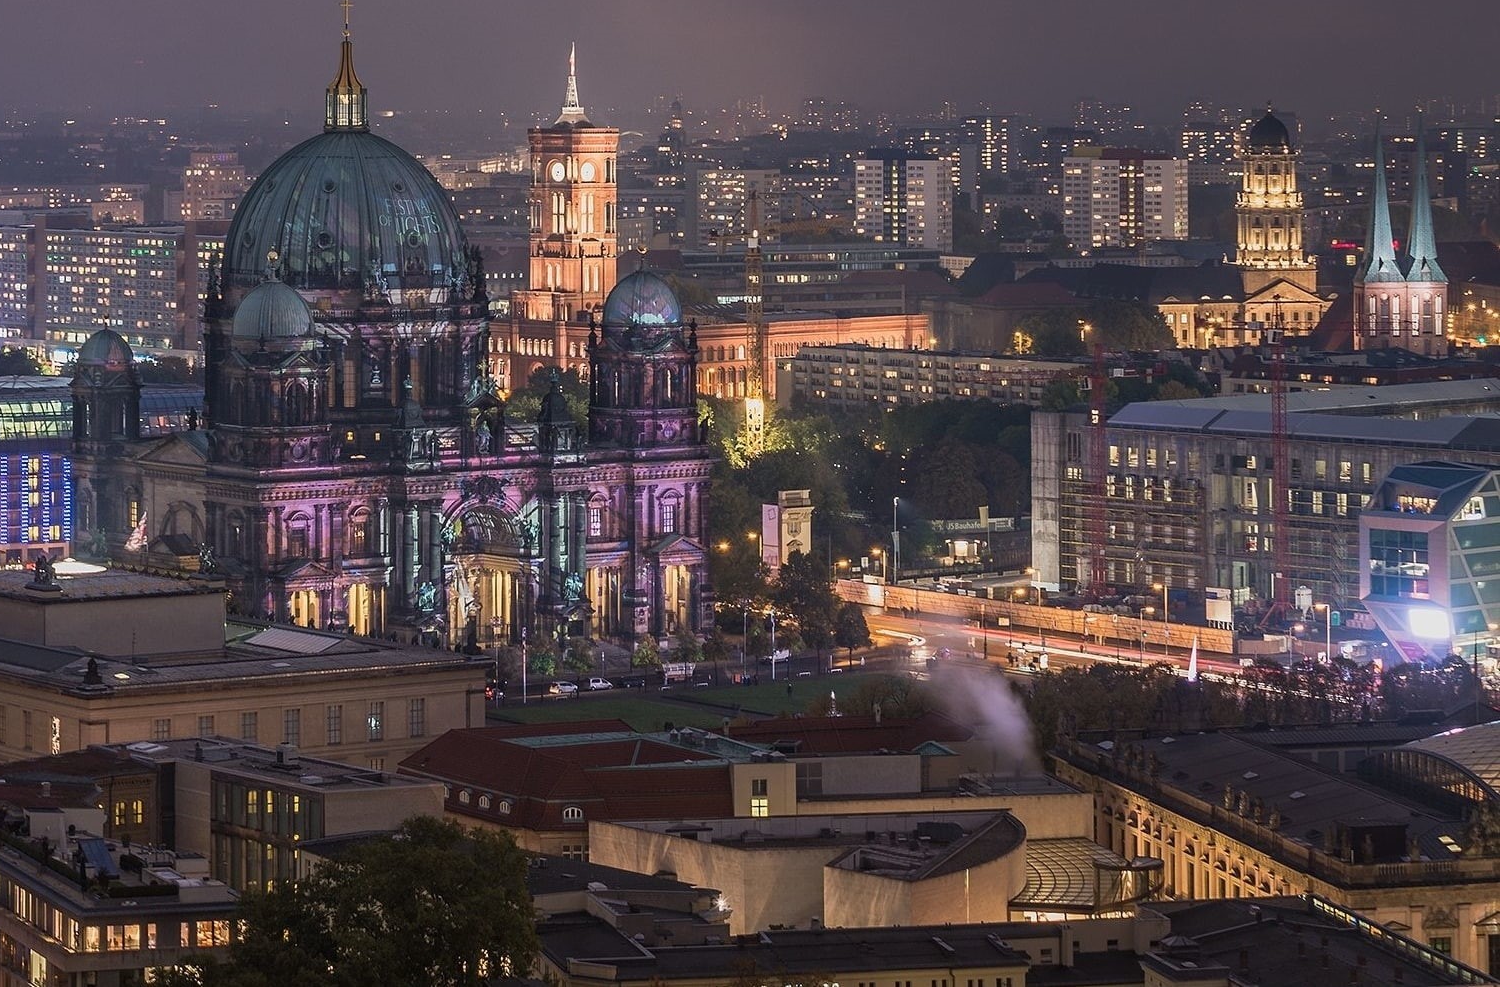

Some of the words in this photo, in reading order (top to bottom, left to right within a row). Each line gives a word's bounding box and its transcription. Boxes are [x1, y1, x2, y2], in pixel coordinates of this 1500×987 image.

[379, 214, 393, 227] OF
[394, 211, 441, 235] LIGHTS
[954, 520, 981, 530] Bauhafe
